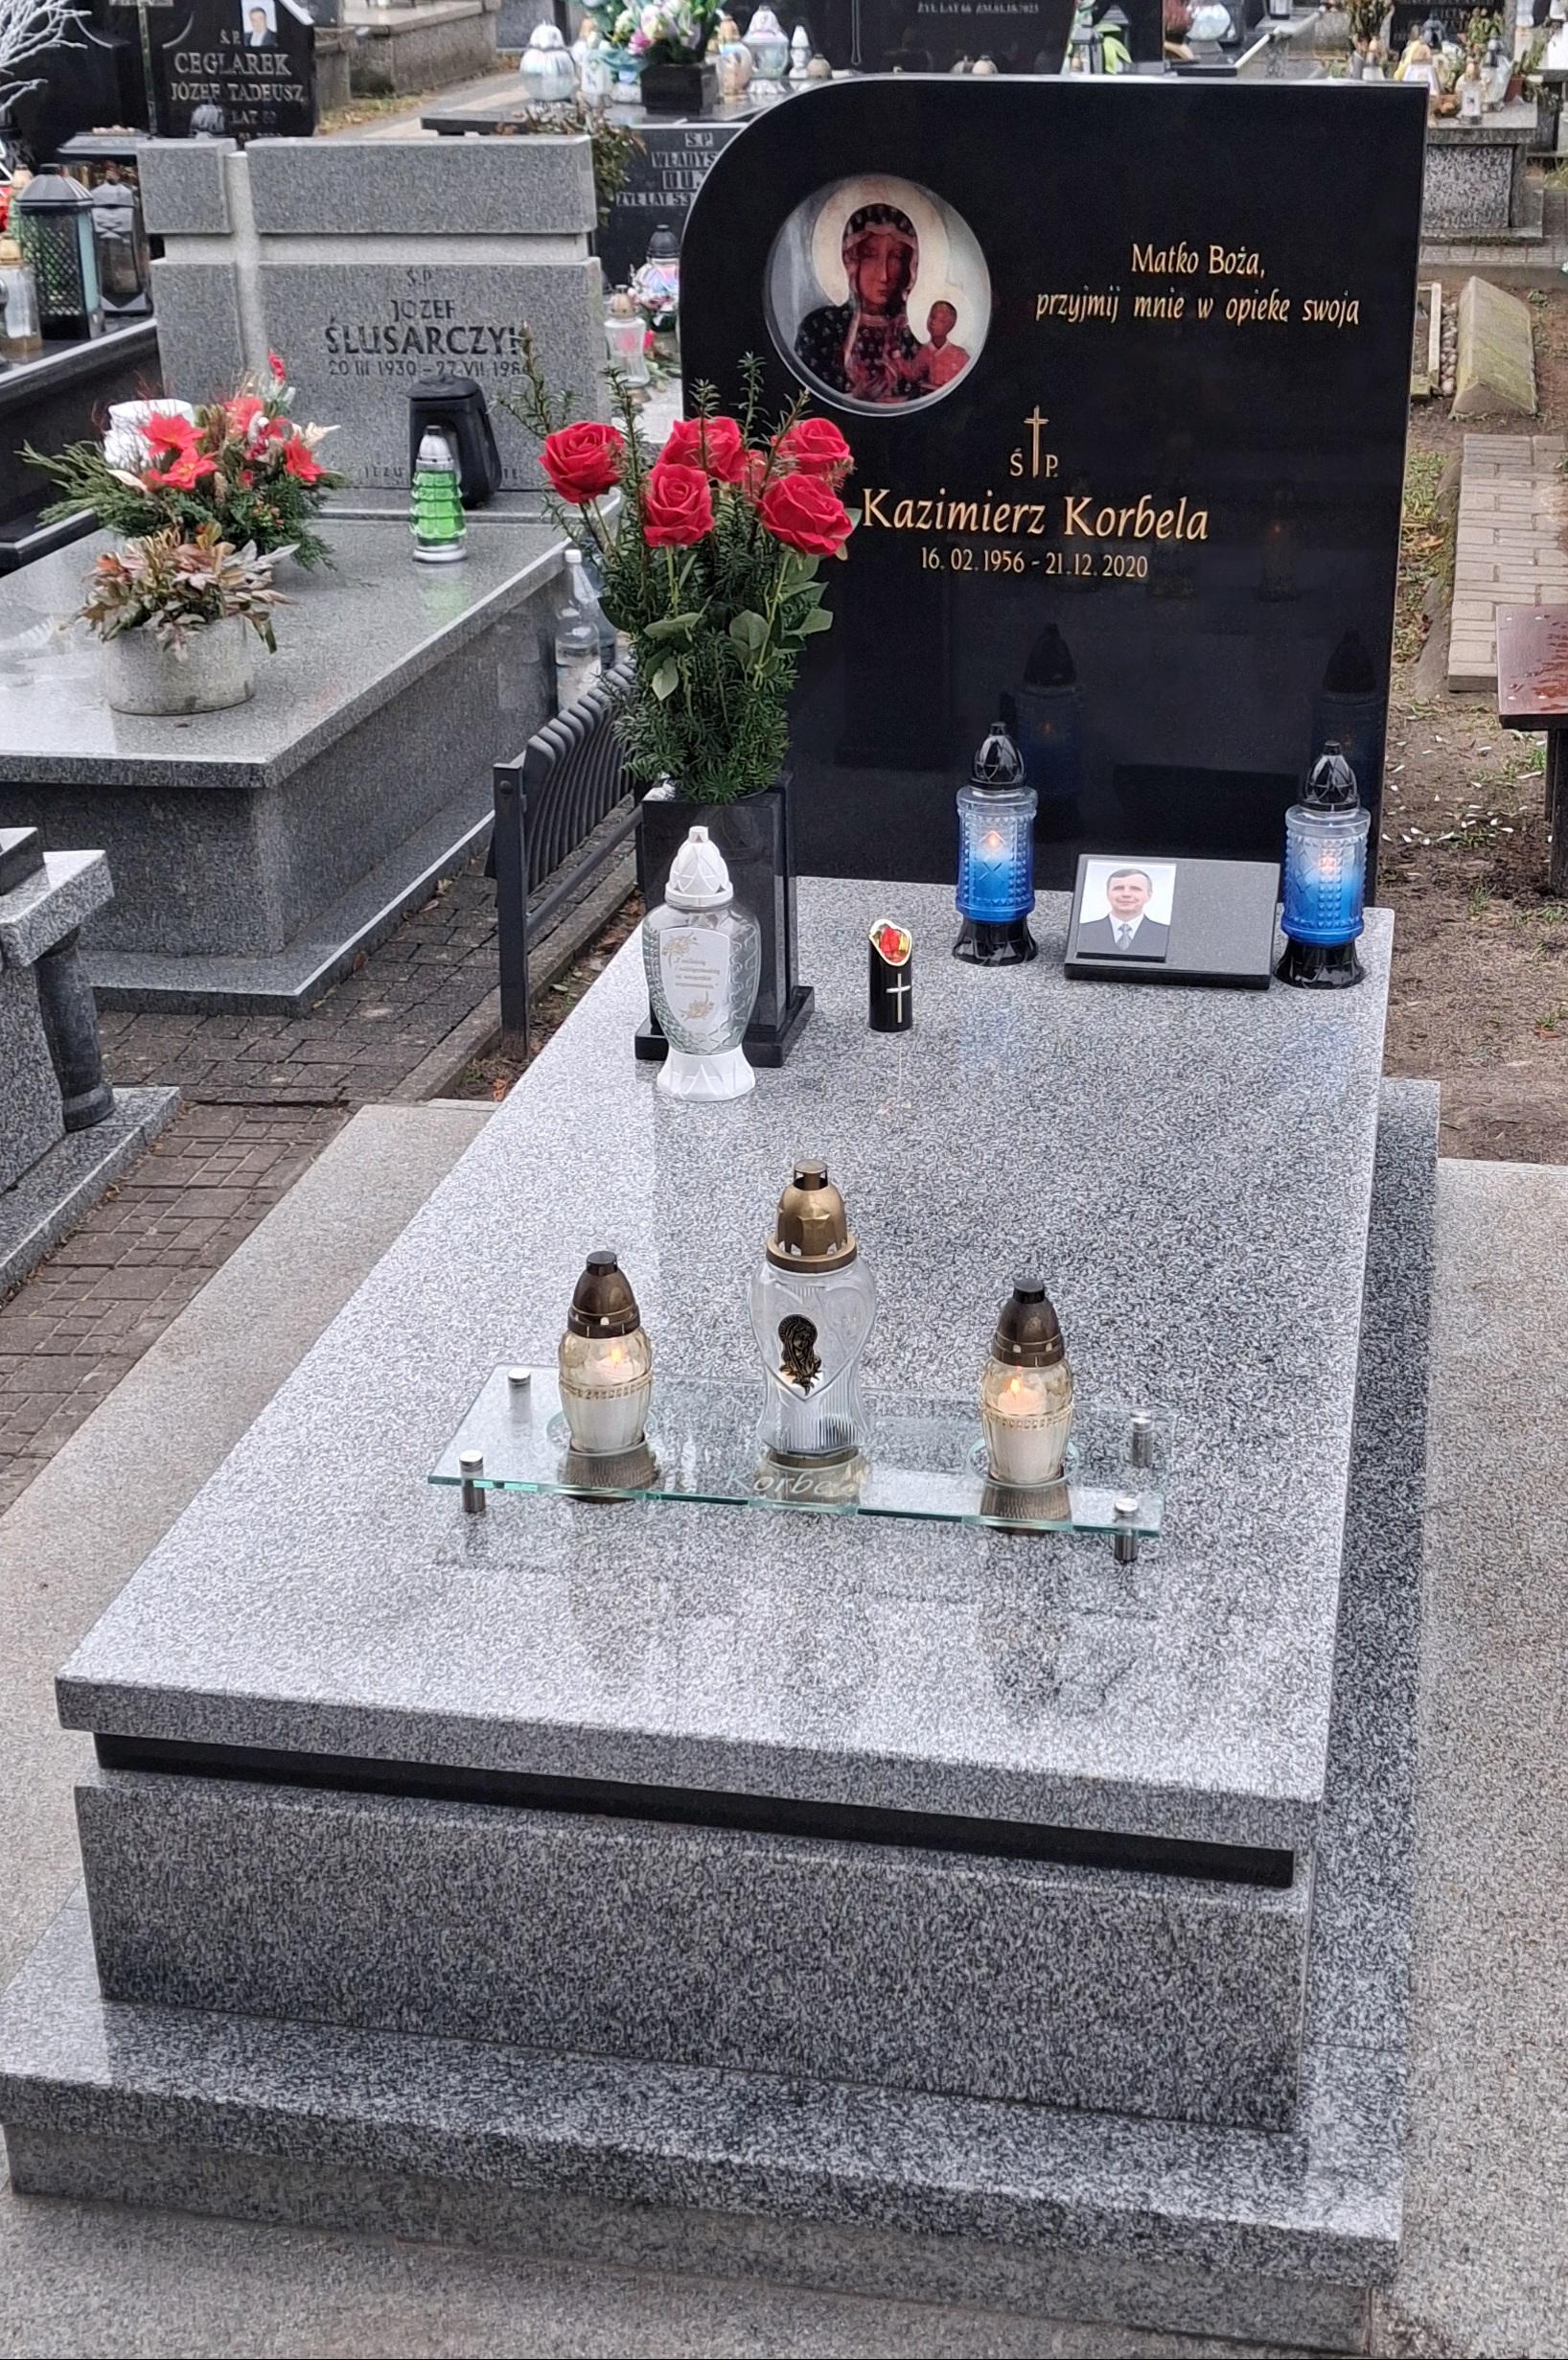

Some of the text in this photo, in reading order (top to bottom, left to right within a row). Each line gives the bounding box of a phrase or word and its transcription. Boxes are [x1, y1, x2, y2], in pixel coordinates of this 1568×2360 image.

[173, 52, 291, 76] CEGLAREK
[227, 82, 304, 102] TADEUSZ
[1131, 242, 1266, 278] Matko Boża,
[1035, 285, 1121, 323] przyjmij
[1133, 288, 1185, 319] mnie
[1197, 296, 1214, 319] w
[378, 359, 417, 377] 1930
[862, 487, 1210, 542] Kazimierz Korbela
